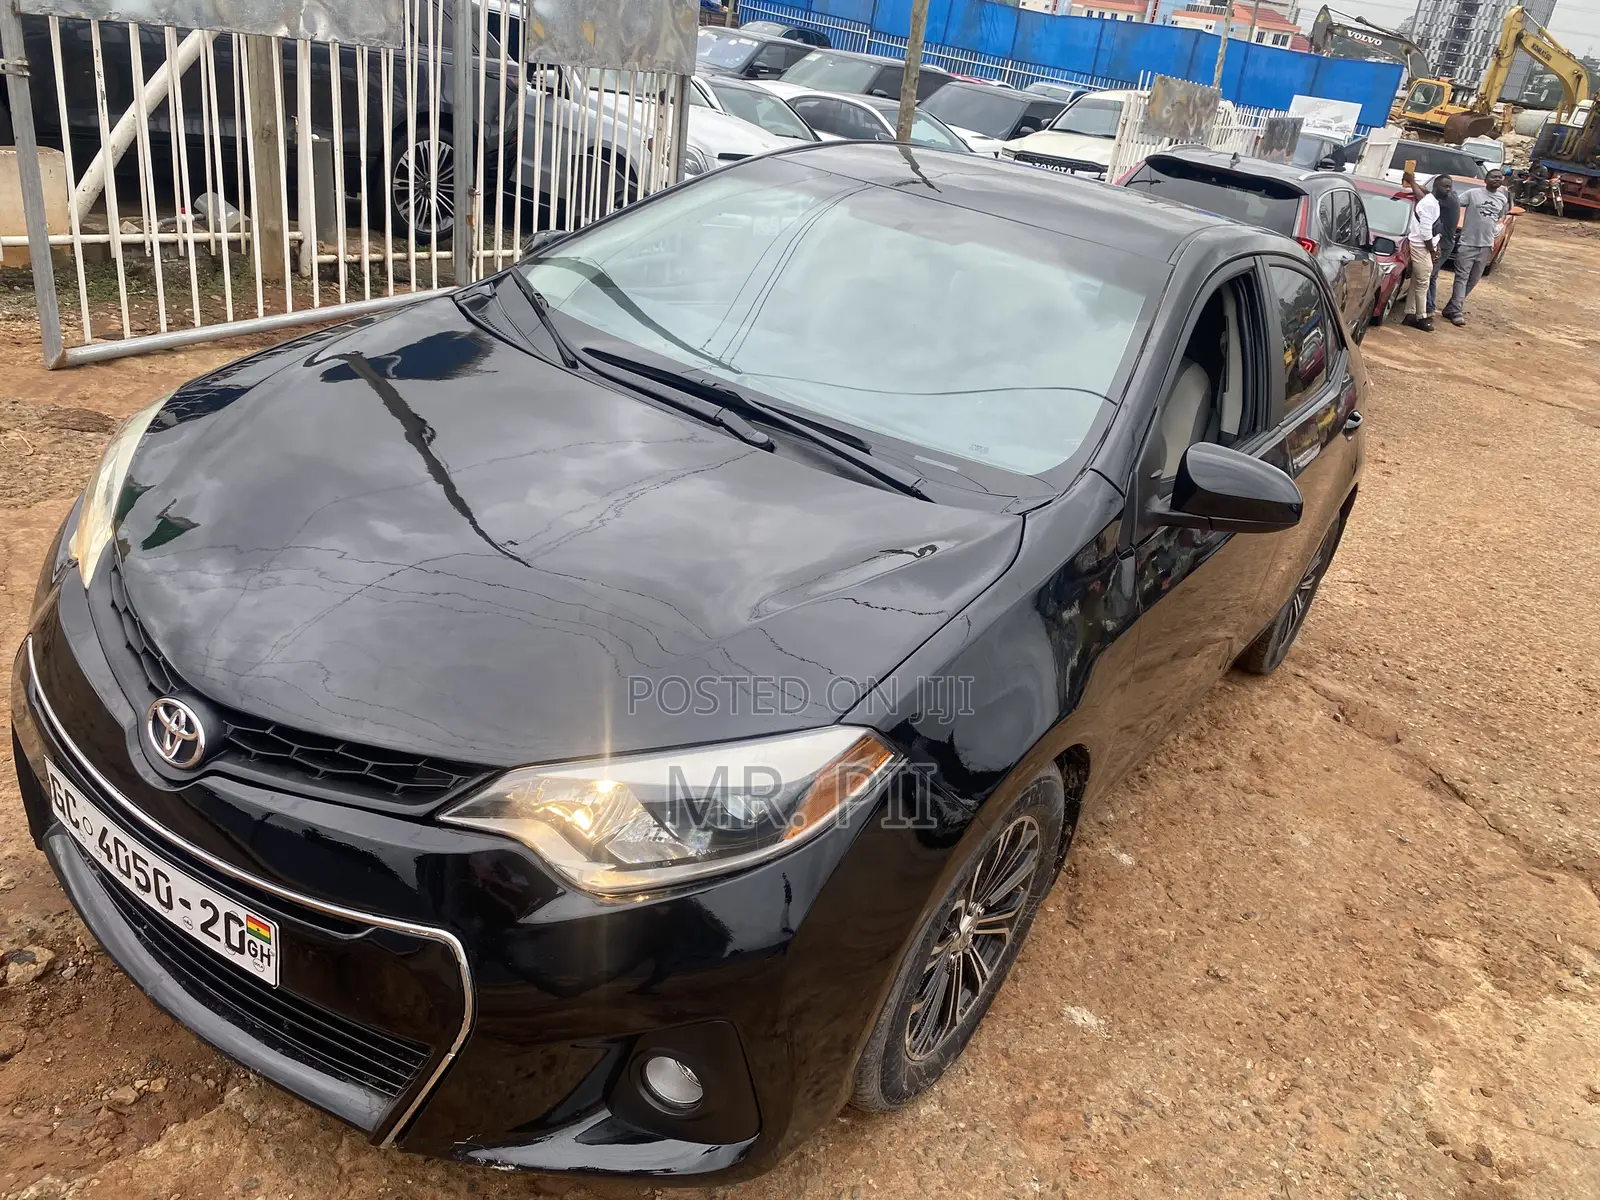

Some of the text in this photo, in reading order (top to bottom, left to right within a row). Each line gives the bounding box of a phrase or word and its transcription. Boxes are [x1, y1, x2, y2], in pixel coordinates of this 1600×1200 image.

[1347, 30, 1382, 46] VOLVO
[1035, 163, 1071, 175] TOYOTA
[50, 772, 80, 830] GC
[247, 939, 271, 967] GH
